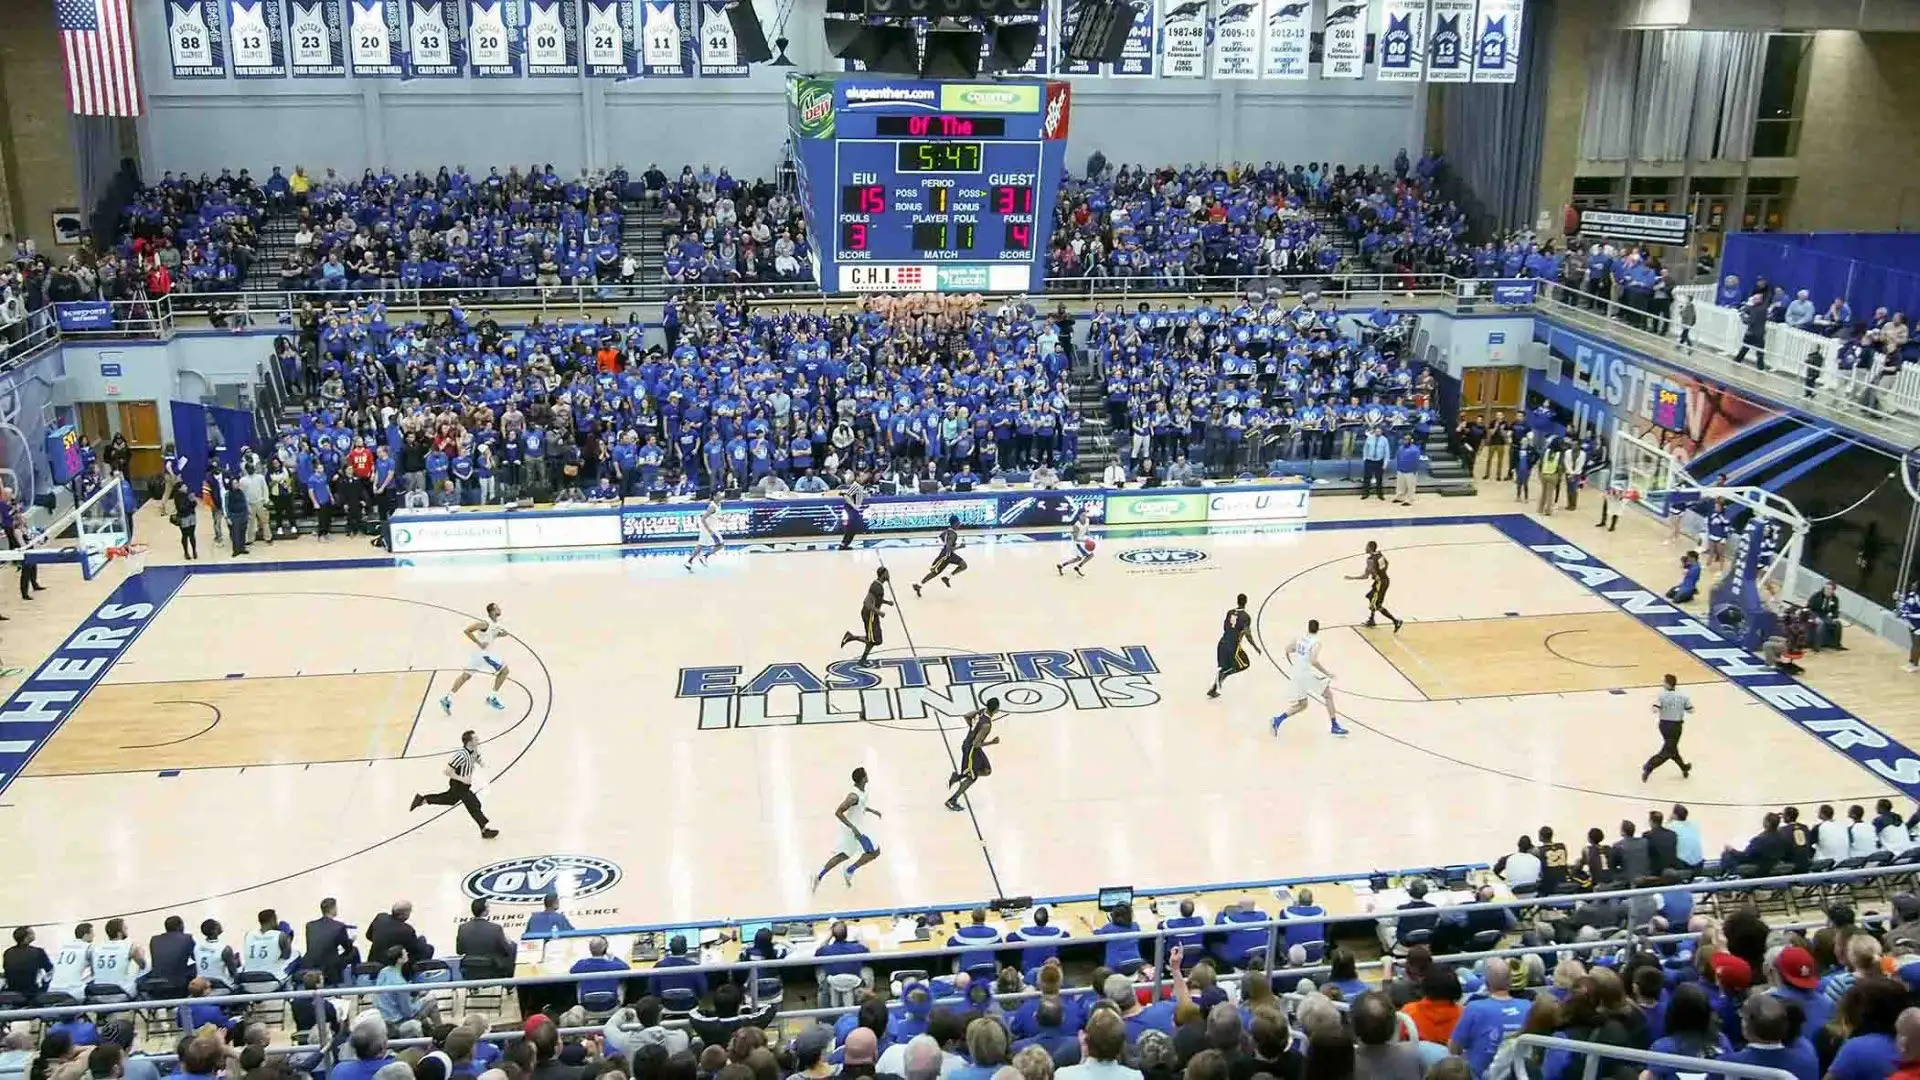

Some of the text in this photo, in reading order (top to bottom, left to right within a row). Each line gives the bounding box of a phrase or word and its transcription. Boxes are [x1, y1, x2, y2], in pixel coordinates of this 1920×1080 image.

[297, 23, 322, 34] EASTERN
[1168, 27, 1203, 38] 1987-88
[1335, 29, 1355, 39] 2001
[181, 37, 200, 49] 88
[243, 37, 260, 49] 13
[301, 36, 320, 48] 23
[361, 36, 379, 48] 20
[420, 36, 439, 48] 43
[480, 36, 498, 48] 20
[537, 36, 556, 48] 00
[595, 36, 613, 48] 24
[654, 37, 670, 49] 11
[709, 37, 727, 49] 44
[1388, 42, 1406, 54] 00
[1438, 43, 1454, 55] 13
[1484, 43, 1501, 56] 44
[176, 67, 224, 75] ANDY SULLIVAN
[604, 66, 628, 74] TAYLOR
[653, 66, 668, 74] KYLE
[845, 87, 936, 102] eiupanthers.com
[909, 116, 973, 135] Of The
[919, 146, 978, 172] 5:47
[853, 173, 877, 184] EIU
[921, 180, 955, 189] PERIOD
[989, 174, 1035, 186] GUEST
[860, 187, 884, 213] 15
[895, 190, 918, 198] POSS
[959, 190, 981, 198] POSS
[999, 187, 1032, 213] 31
[895, 203, 922, 212] BONUS
[953, 203, 980, 212] BONUS
[840, 214, 870, 223] FOULS
[912, 214, 979, 223] PLAYER FOUL
[1003, 214, 1033, 223] FOULS
[852, 224, 865, 249] 3
[940, 226, 973, 249] 1 1
[1013, 224, 1029, 249] 4
[838, 250, 871, 260] SCORE
[924, 250, 958, 260] MATCH
[999, 250, 1032, 260] SCORE
[1572, 344, 1706, 441] EASTEN
[1530, 544, 1920, 784] PANTHERS
[675, 645, 1161, 699] EASTERN
[697, 675, 1163, 731] ILLINOIS
[491, 863, 588, 893] OVC
[453, 913, 524, 924] INSIRING
[57, 950, 77, 966] 10
[249, 944, 268, 960] 15
[96, 954, 116, 970] 55
